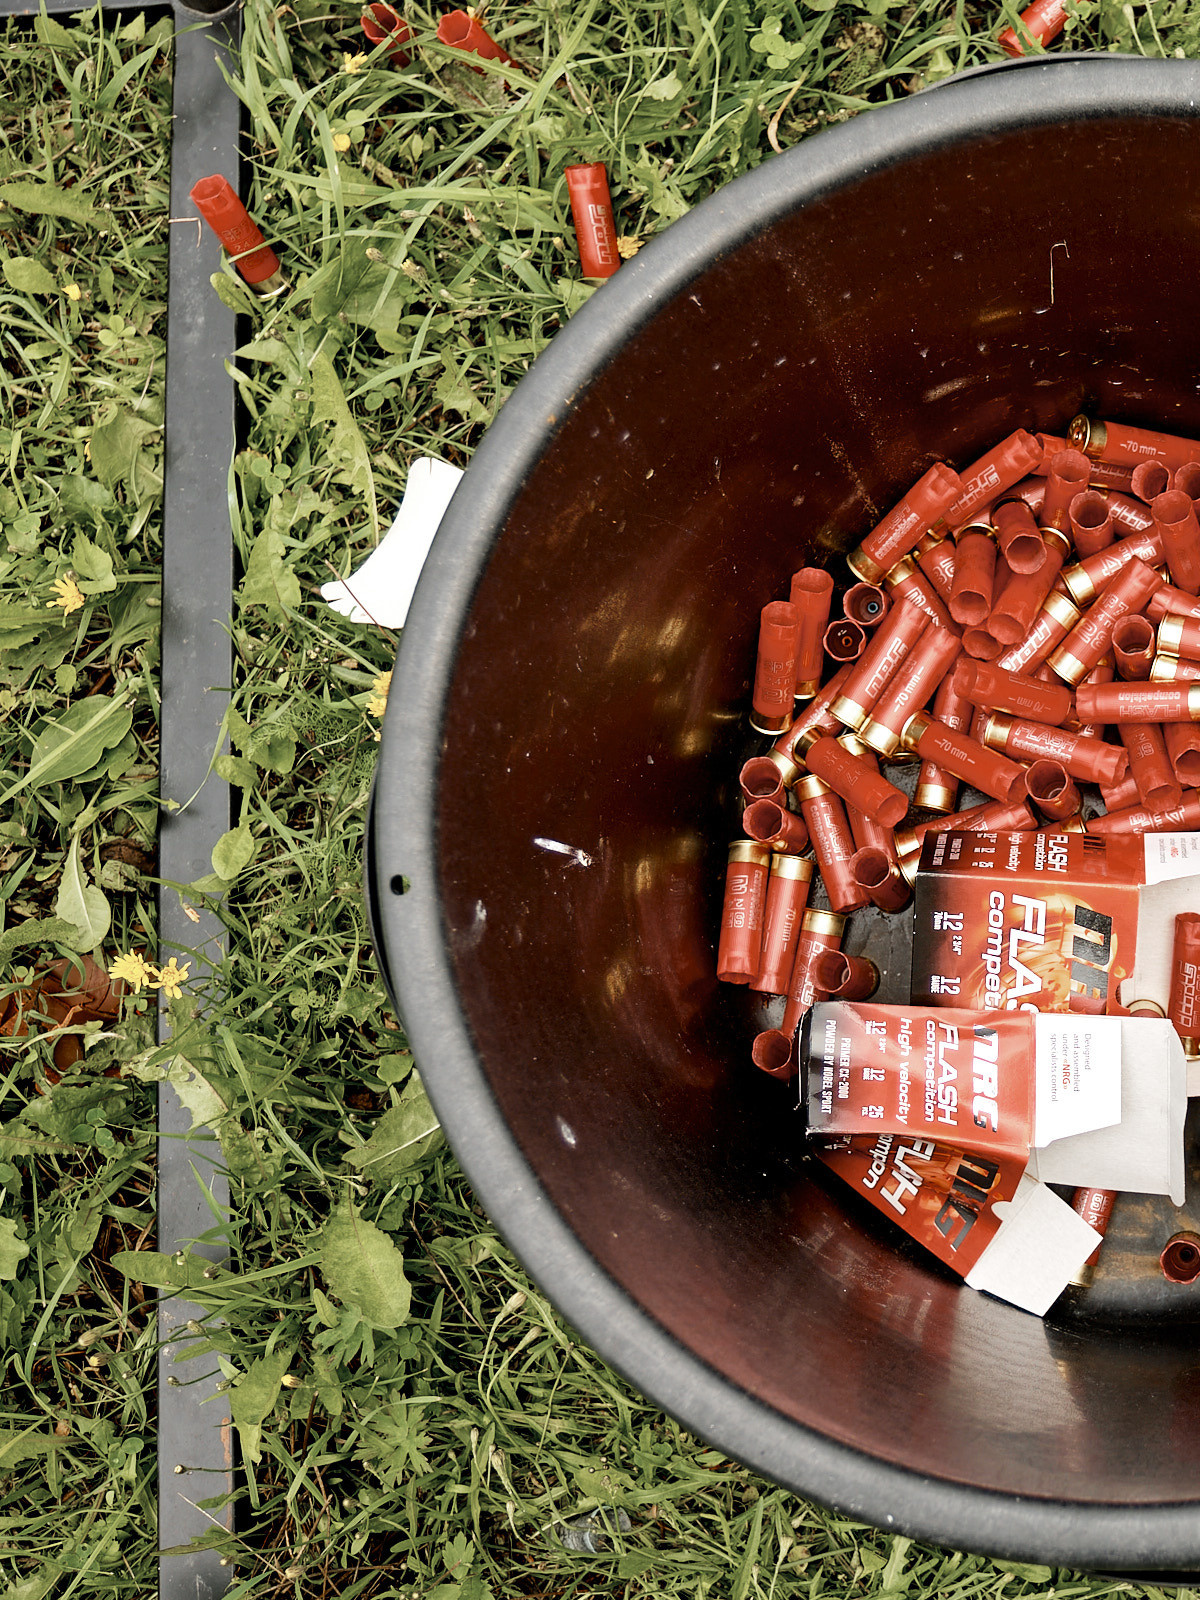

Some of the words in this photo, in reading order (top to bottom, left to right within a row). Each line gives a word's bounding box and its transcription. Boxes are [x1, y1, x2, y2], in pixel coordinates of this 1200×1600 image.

[1034, 833, 1046, 871] competition
[1047, 834, 1069, 873] FLASH
[943, 911, 964, 932] 12
[940, 975, 962, 996] 12
[823, 1019, 837, 1052] POWDER
[871, 1020, 887, 1036] 12
[897, 1017, 913, 1057] high
[1073, 1033, 1081, 1049] and
[823, 1053, 835, 1065] BY
[839, 1036, 851, 1067] PRIMER
[1050, 1033, 1059, 1073] specialists
[1083, 1033, 1092, 1071] Designed
[822, 1065, 835, 1091] NOBEL
[838, 1067, 851, 1099] CX-2000
[870, 1067, 886, 1082] 12
[923, 1019, 937, 1123] competition
[937, 1022, 960, 1127] FLASH
[1073, 1050, 1081, 1092] assembled
[821, 1090, 833, 1115] SPORT
[895, 1061, 912, 1125] velocity
[1051, 1074, 1059, 1102] control
[868, 1105, 885, 1119] 25
